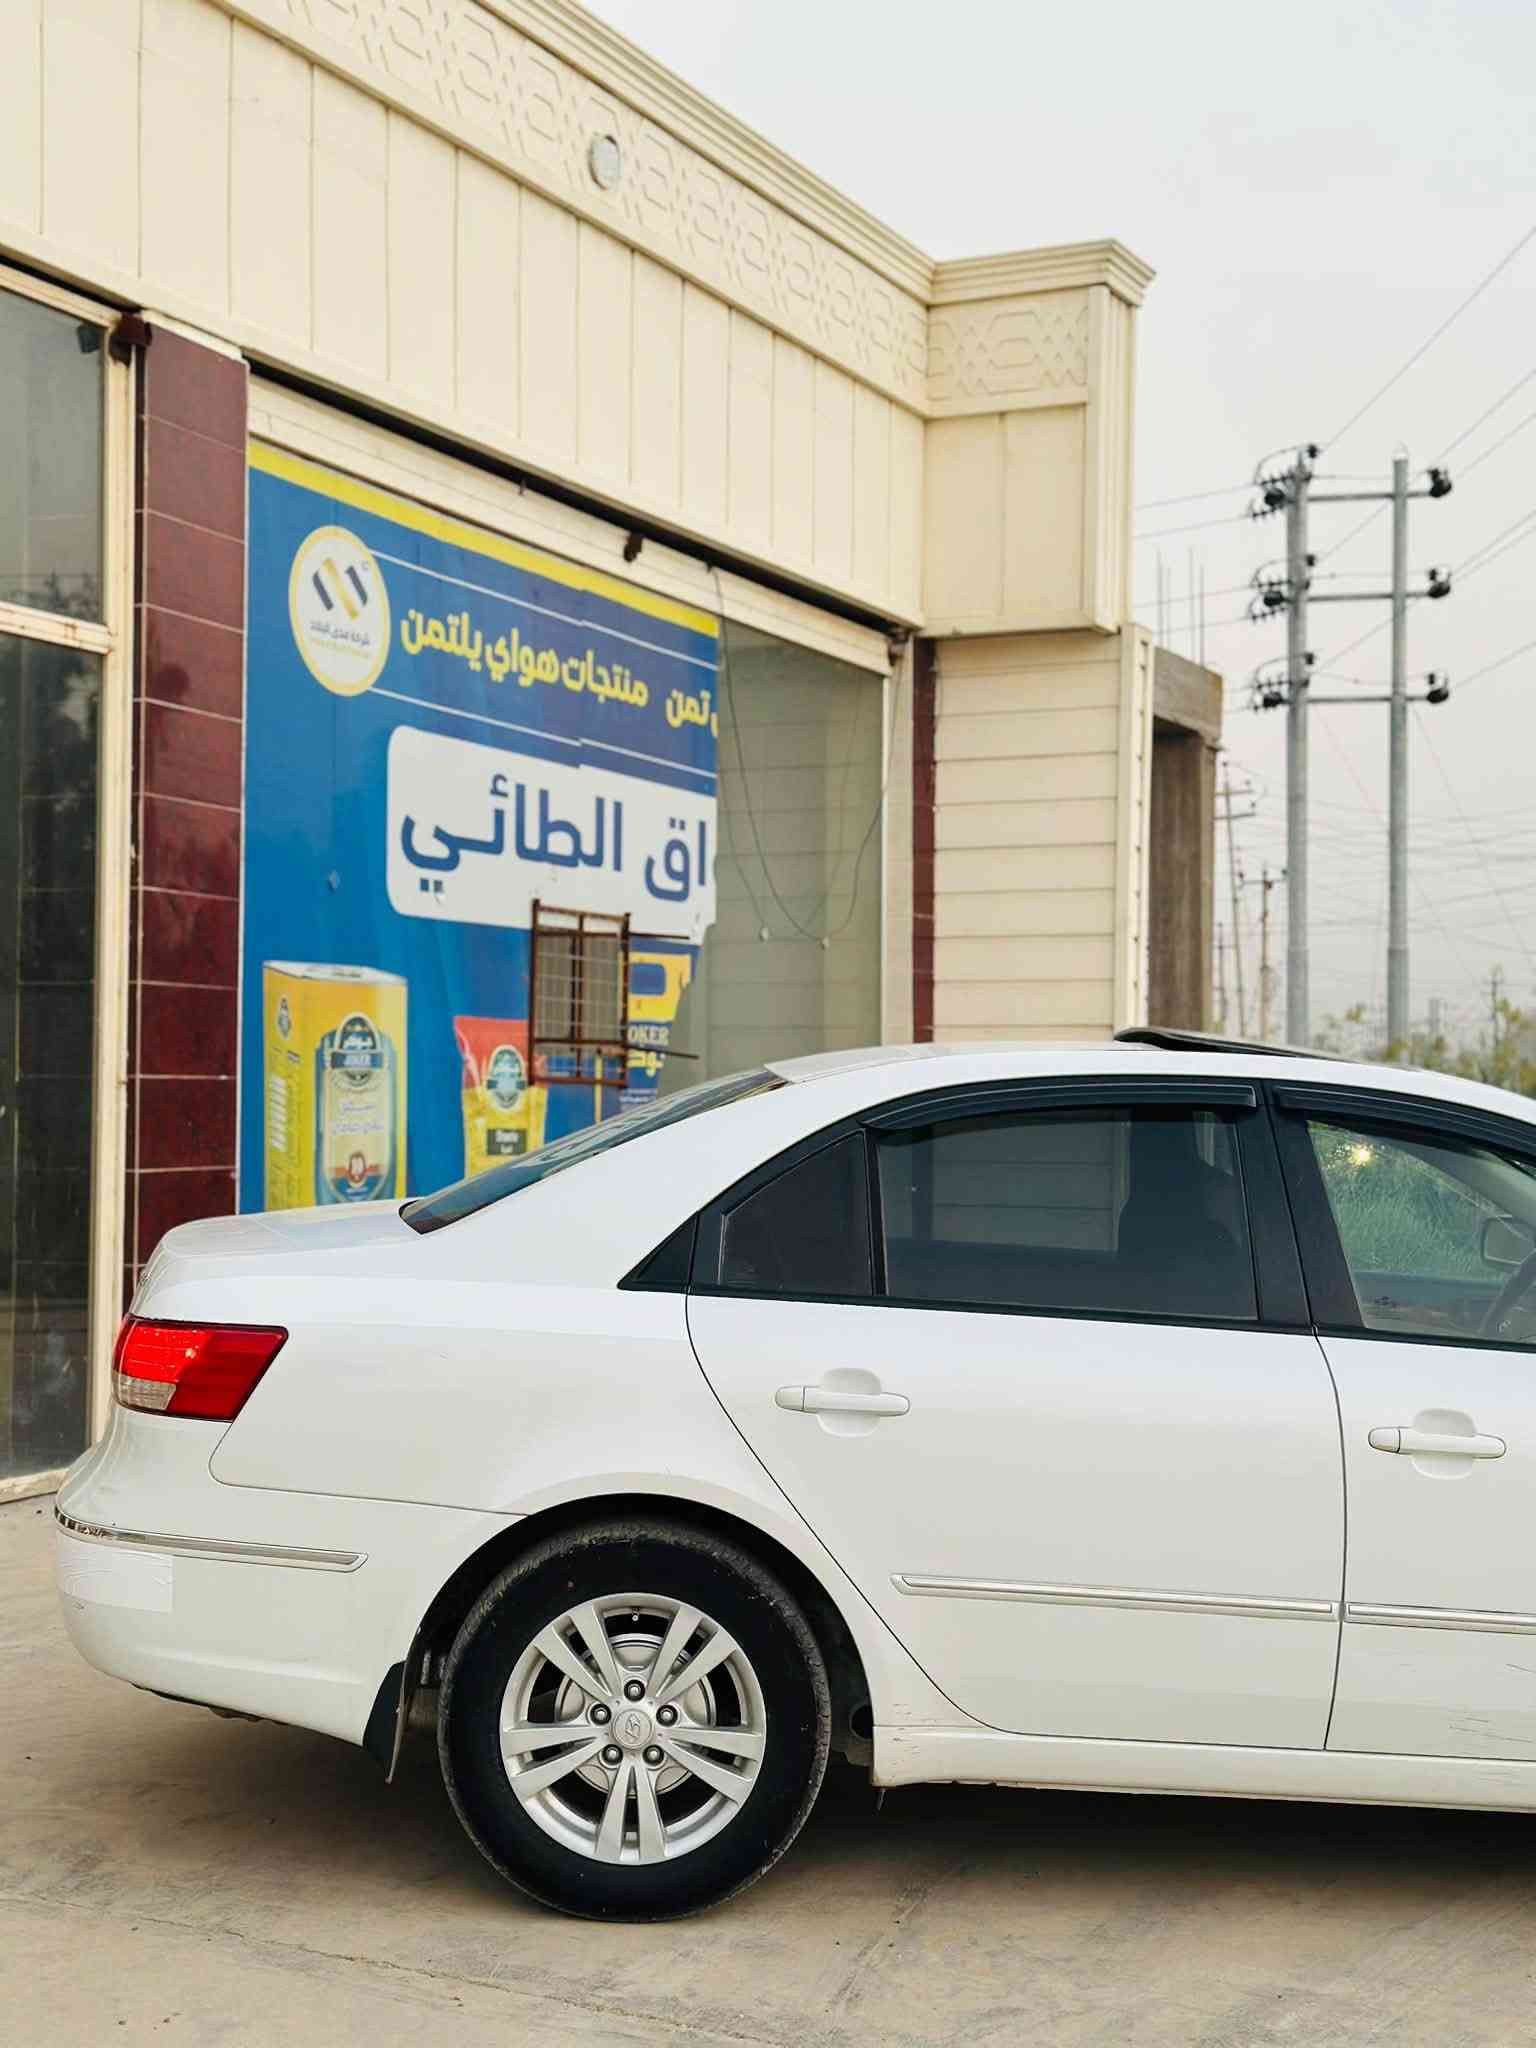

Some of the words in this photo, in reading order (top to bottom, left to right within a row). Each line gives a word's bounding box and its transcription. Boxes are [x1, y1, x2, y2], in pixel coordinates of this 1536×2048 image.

[561, 649, 649, 707] منتجات
[401, 773, 622, 893] الطائي
[627, 1025, 670, 1046] OKER
